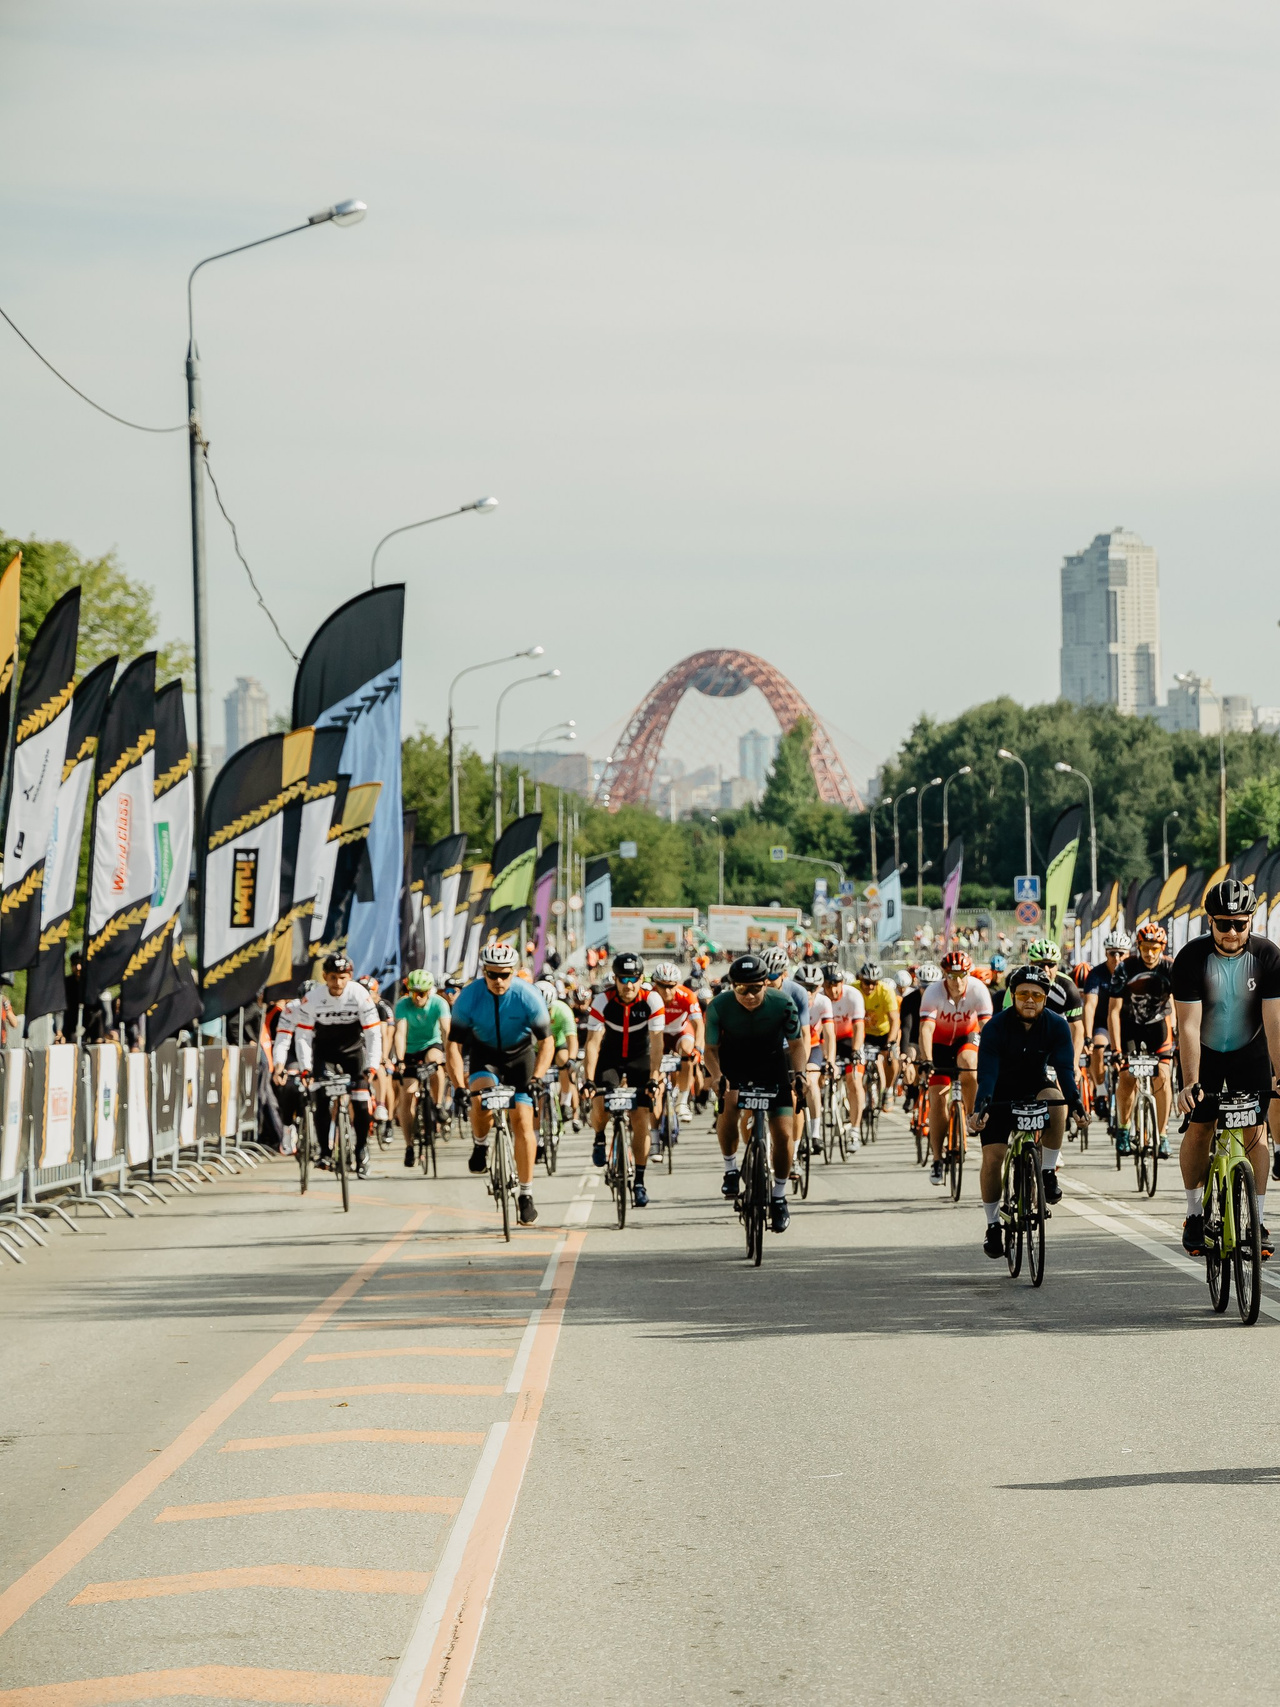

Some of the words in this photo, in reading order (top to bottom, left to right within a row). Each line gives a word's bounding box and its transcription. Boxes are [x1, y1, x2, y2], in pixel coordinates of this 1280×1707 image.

[744, 1097, 769, 1110] 3016
[1017, 1115, 1044, 1130] 3246
[1225, 1109, 1257, 1128] 3250
